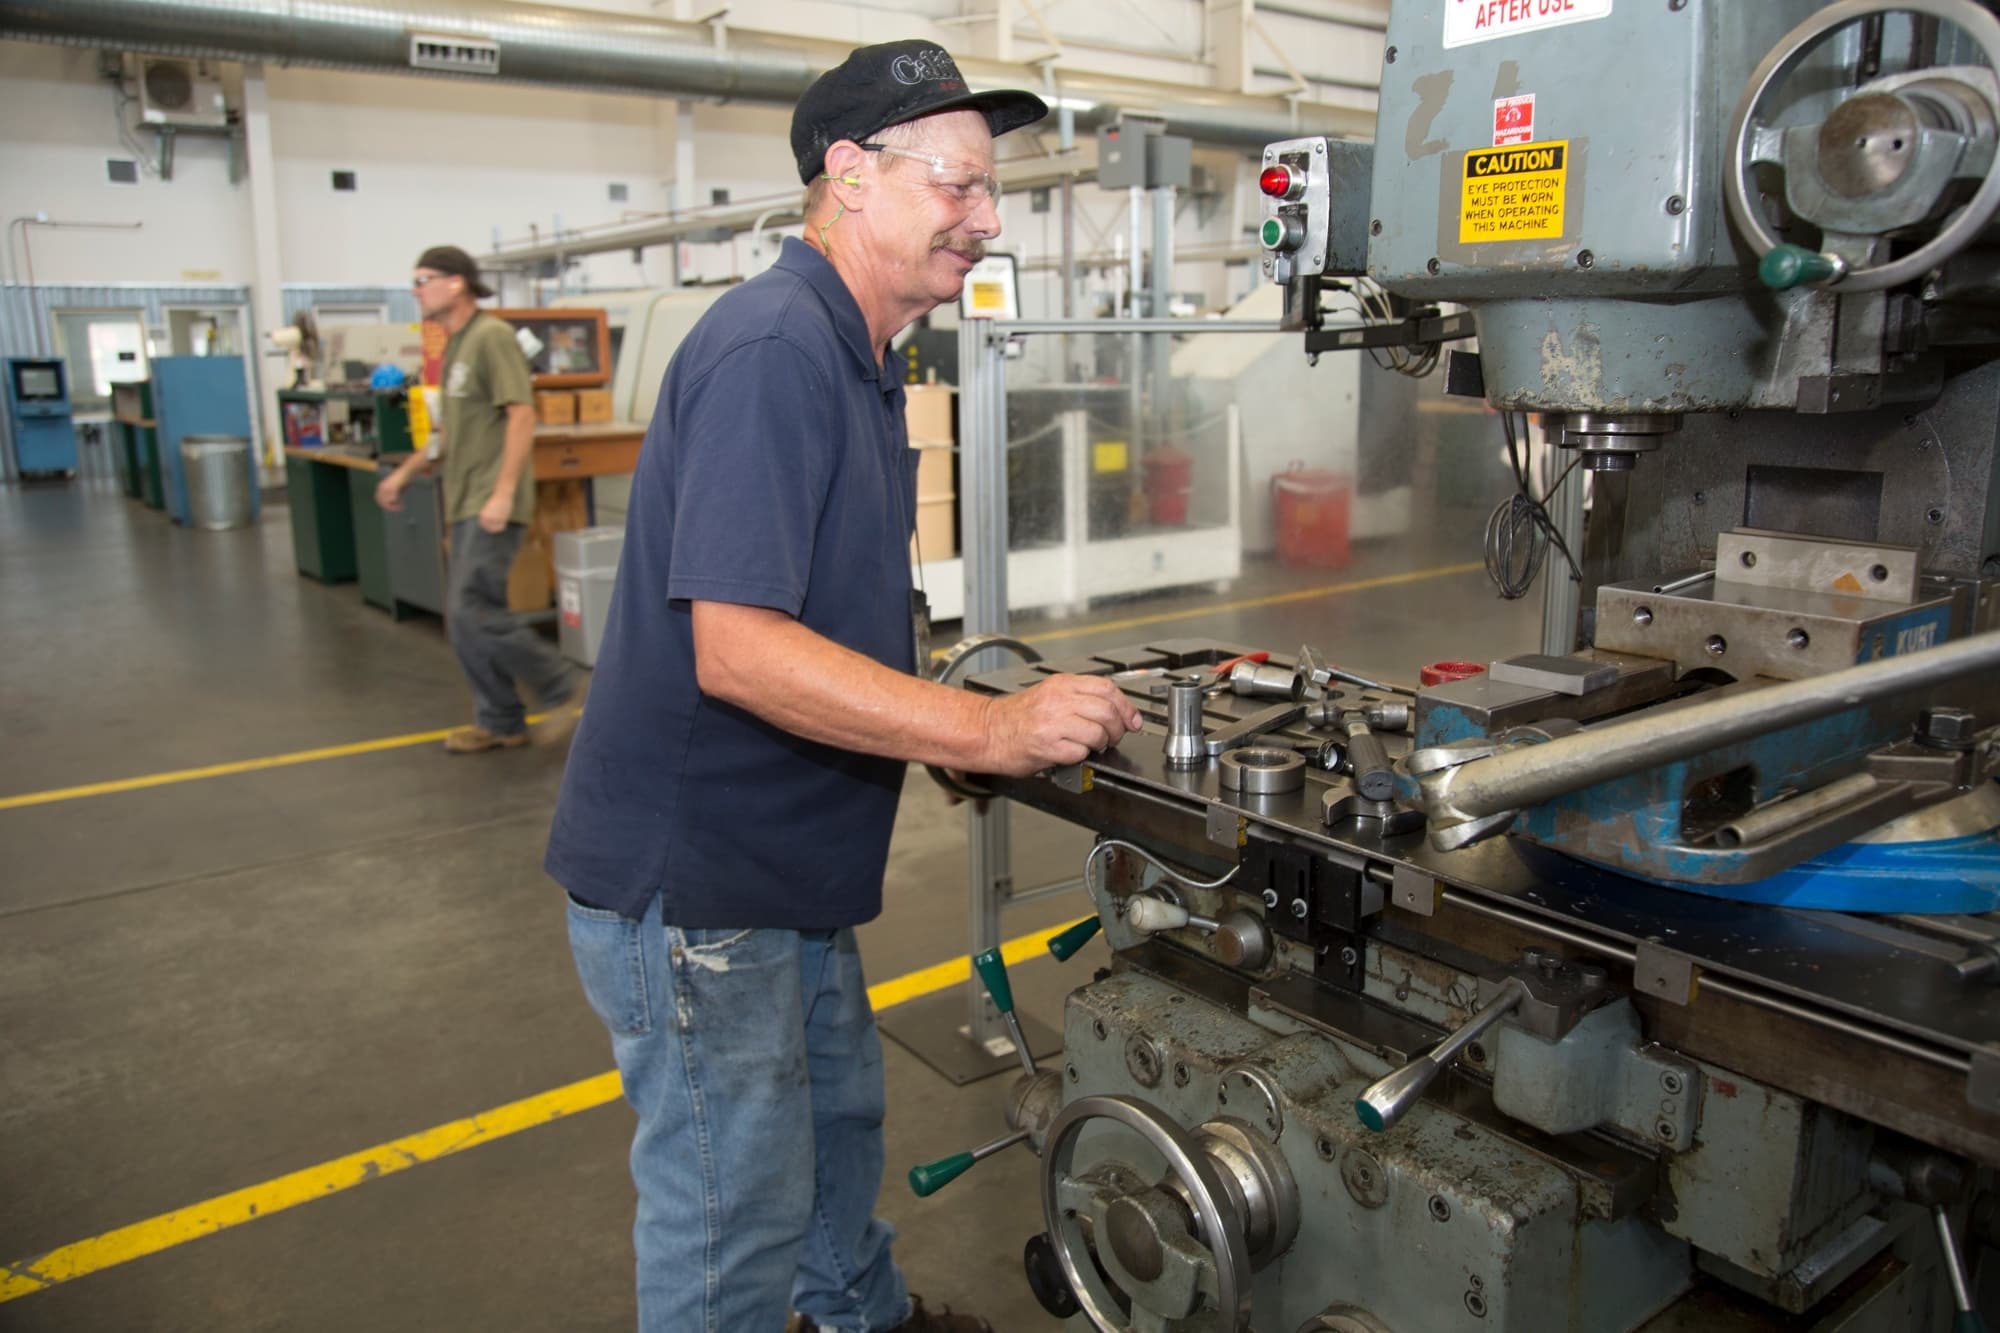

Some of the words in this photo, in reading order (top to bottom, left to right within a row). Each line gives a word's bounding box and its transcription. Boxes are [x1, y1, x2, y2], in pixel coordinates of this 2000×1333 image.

[1475, 0, 1531, 29] AFTER
[1475, 149, 1554, 175] CAUTION
[1468, 184, 1489, 195] EYE
[1493, 178, 1560, 192] PROTECTION
[1472, 196, 1499, 207] MUST
[1503, 194, 1517, 205] BE
[1522, 192, 1554, 203] WORN
[1465, 210, 1495, 221] WHEN
[1498, 204, 1559, 218] OPERATING
[1473, 221, 1496, 232] THIS
[1499, 218, 1549, 231] MACHINE
[1896, 622, 1937, 655] KURT
